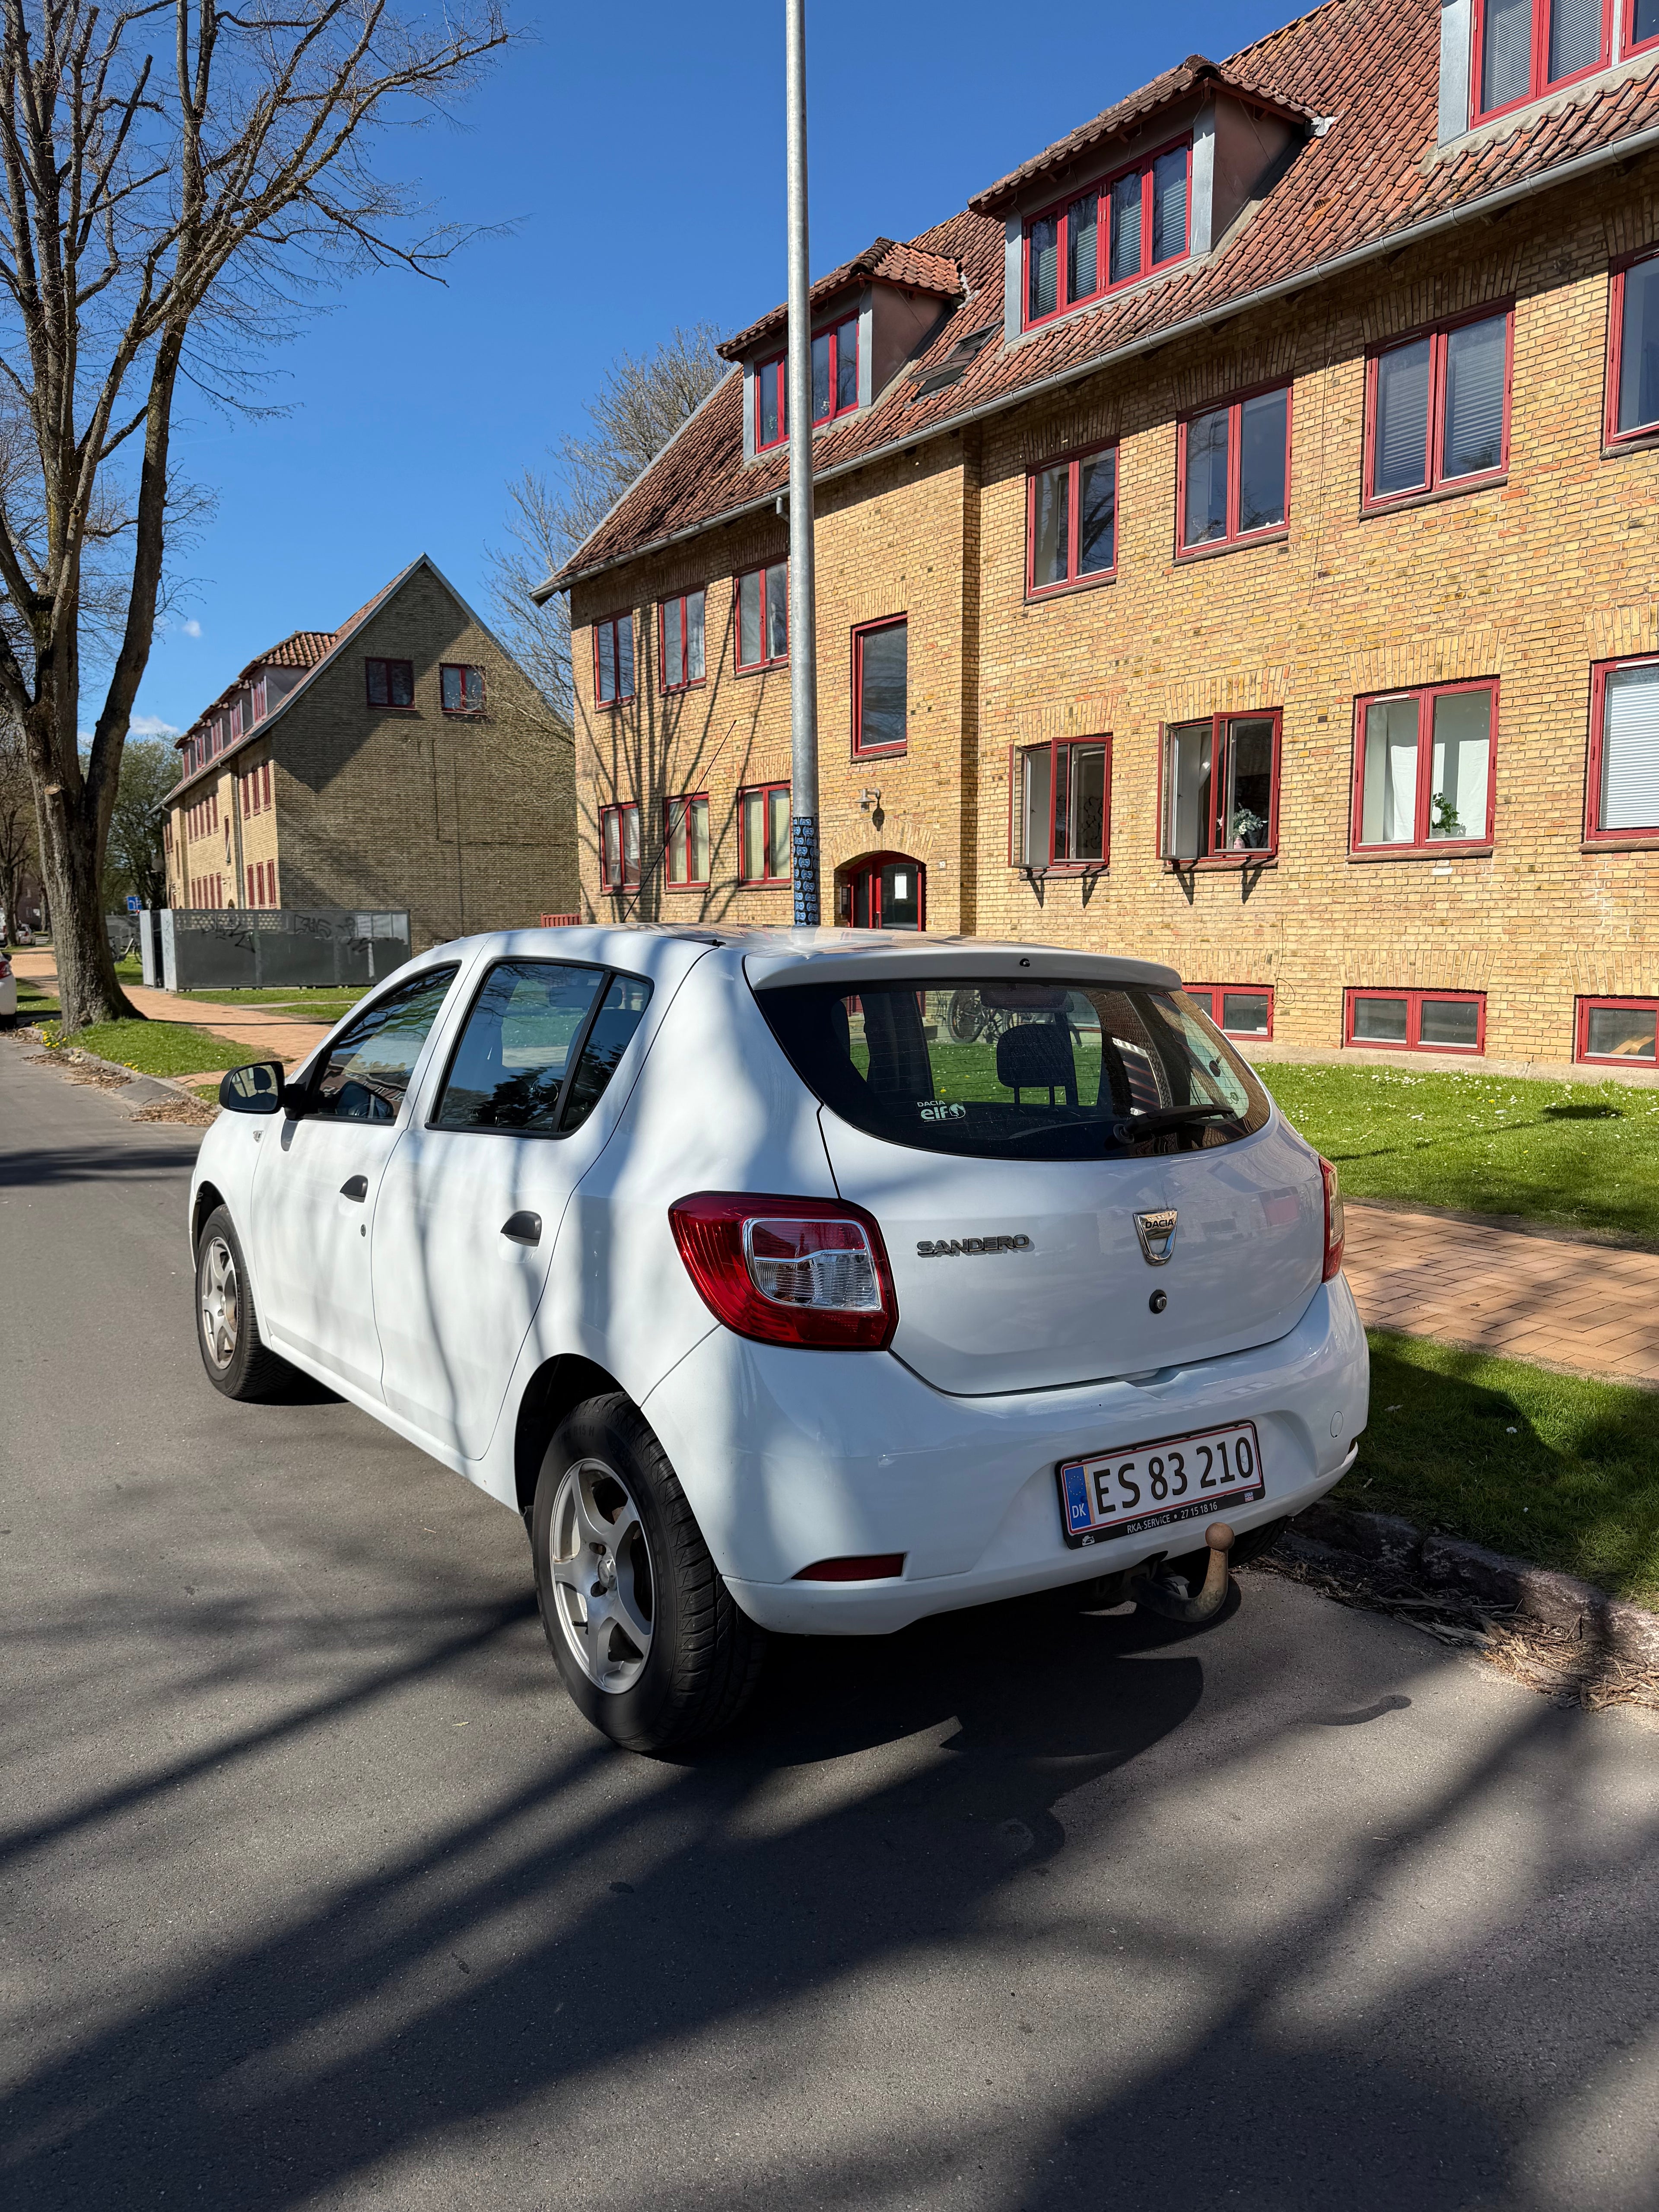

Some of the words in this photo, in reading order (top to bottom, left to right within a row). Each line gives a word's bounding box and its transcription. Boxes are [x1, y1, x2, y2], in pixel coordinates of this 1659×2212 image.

[921, 1106, 948, 1120] elf
[1145, 1218, 1174, 1229] DACIA
[917, 1234, 1030, 1255] SANDERO
[1093, 1463, 1140, 1514] ES
[1148, 1452, 1187, 1500] 83
[1196, 1437, 1253, 1488] 210
[1072, 1503, 1086, 1519] DK
[1127, 1514, 1170, 1534] RKA-SERVICE
[1181, 1510, 1188, 1519] 27
[1191, 1507, 1198, 1516] 15
[1200, 1504, 1208, 1513] 18
[1210, 1502, 1217, 1511] 16
